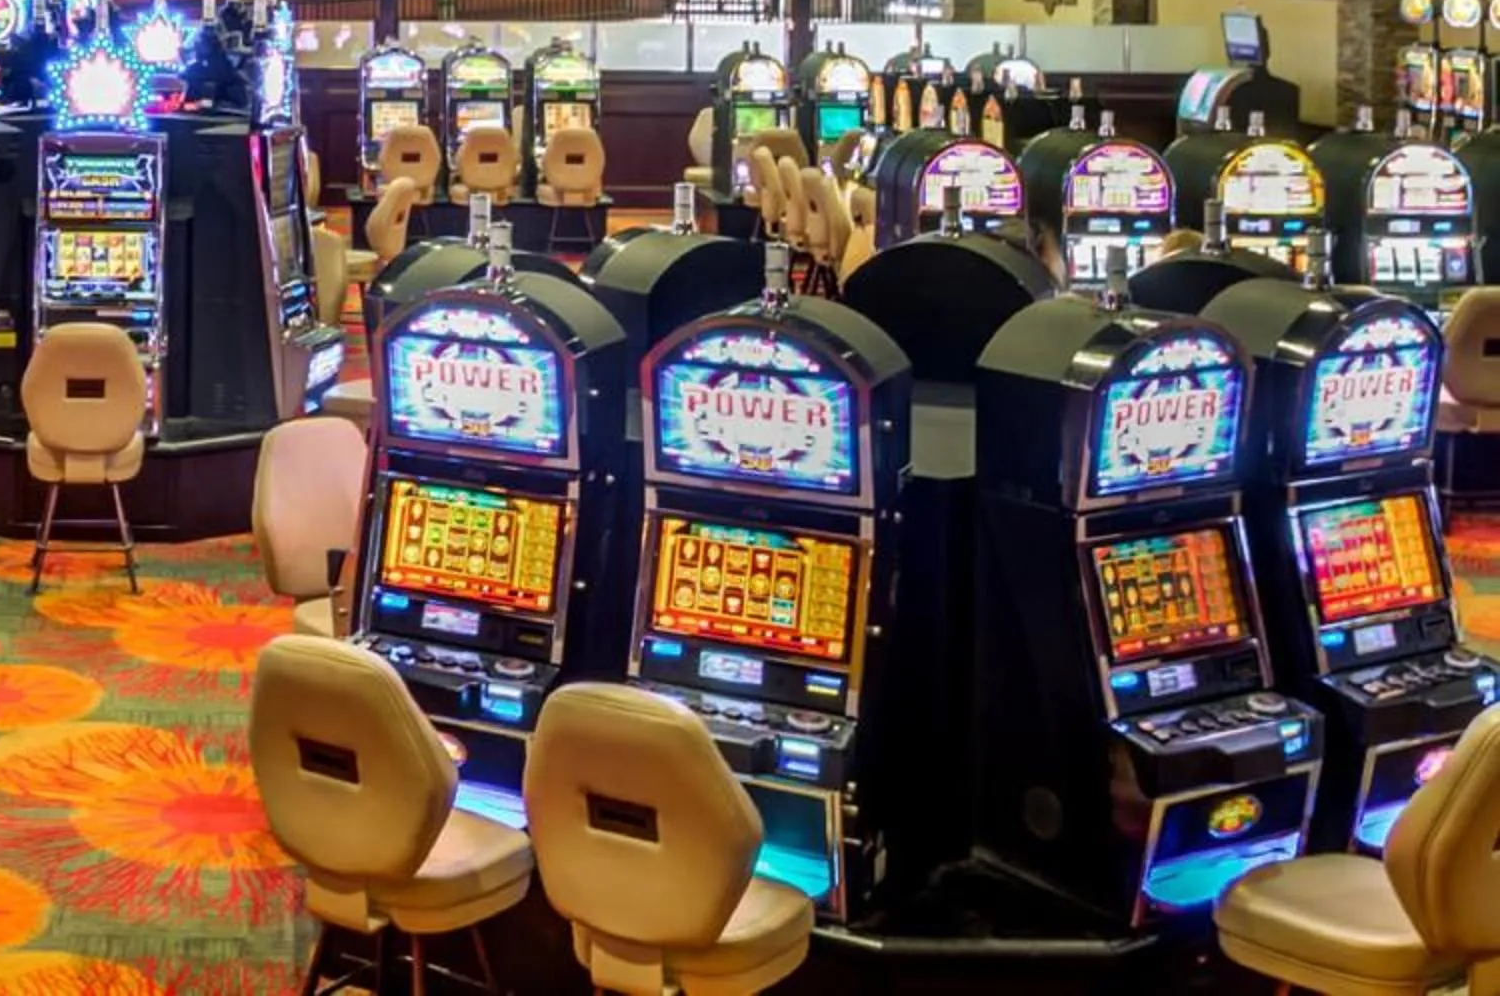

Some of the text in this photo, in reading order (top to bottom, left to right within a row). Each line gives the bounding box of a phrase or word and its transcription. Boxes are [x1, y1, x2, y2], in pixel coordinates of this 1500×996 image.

[415, 357, 540, 395] POWER
[1322, 367, 1415, 404] POWER
[685, 387, 830, 428] POWER
[1114, 390, 1218, 430] POWER
